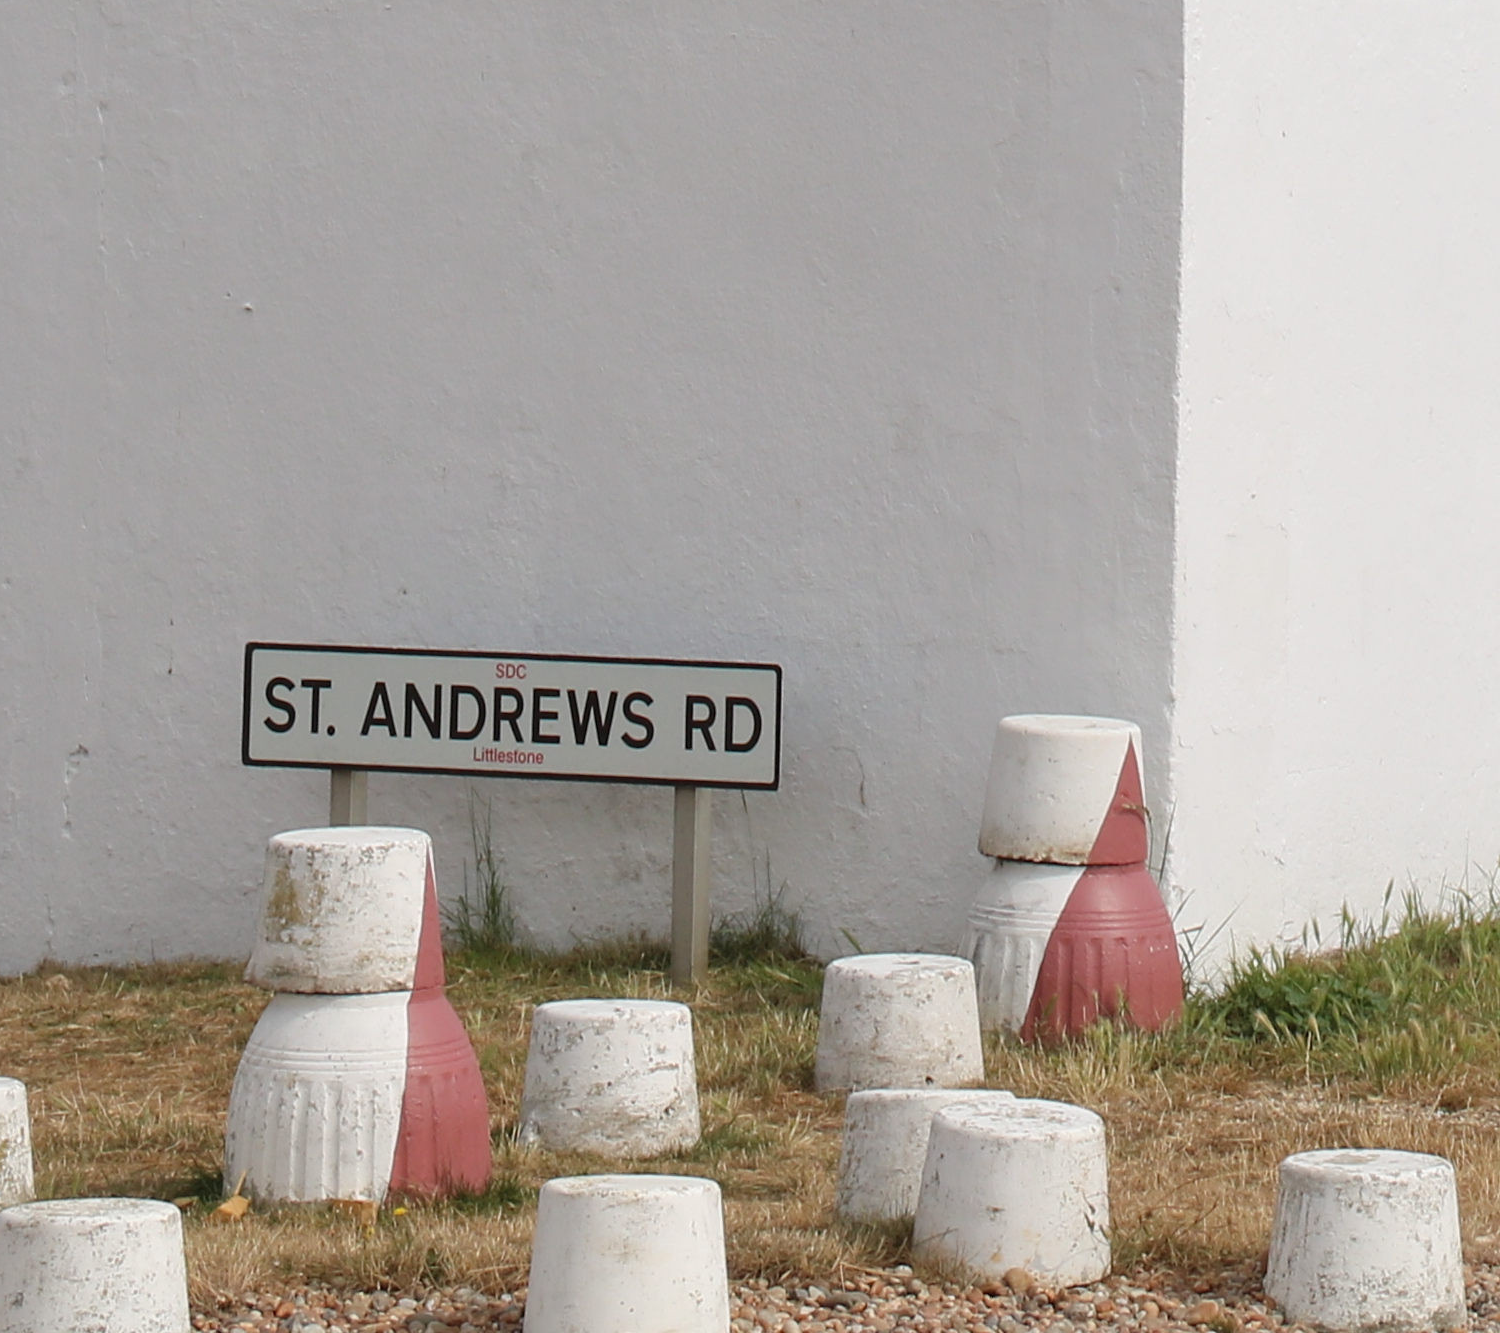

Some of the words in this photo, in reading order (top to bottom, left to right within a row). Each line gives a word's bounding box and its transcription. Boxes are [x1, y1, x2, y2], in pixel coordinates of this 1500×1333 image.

[495, 663, 527, 680] SDC
[263, 676, 336, 737] ST.
[360, 681, 655, 749] ANDREWS
[684, 694, 763, 754] RD
[472, 746, 544, 765] Littlestone
